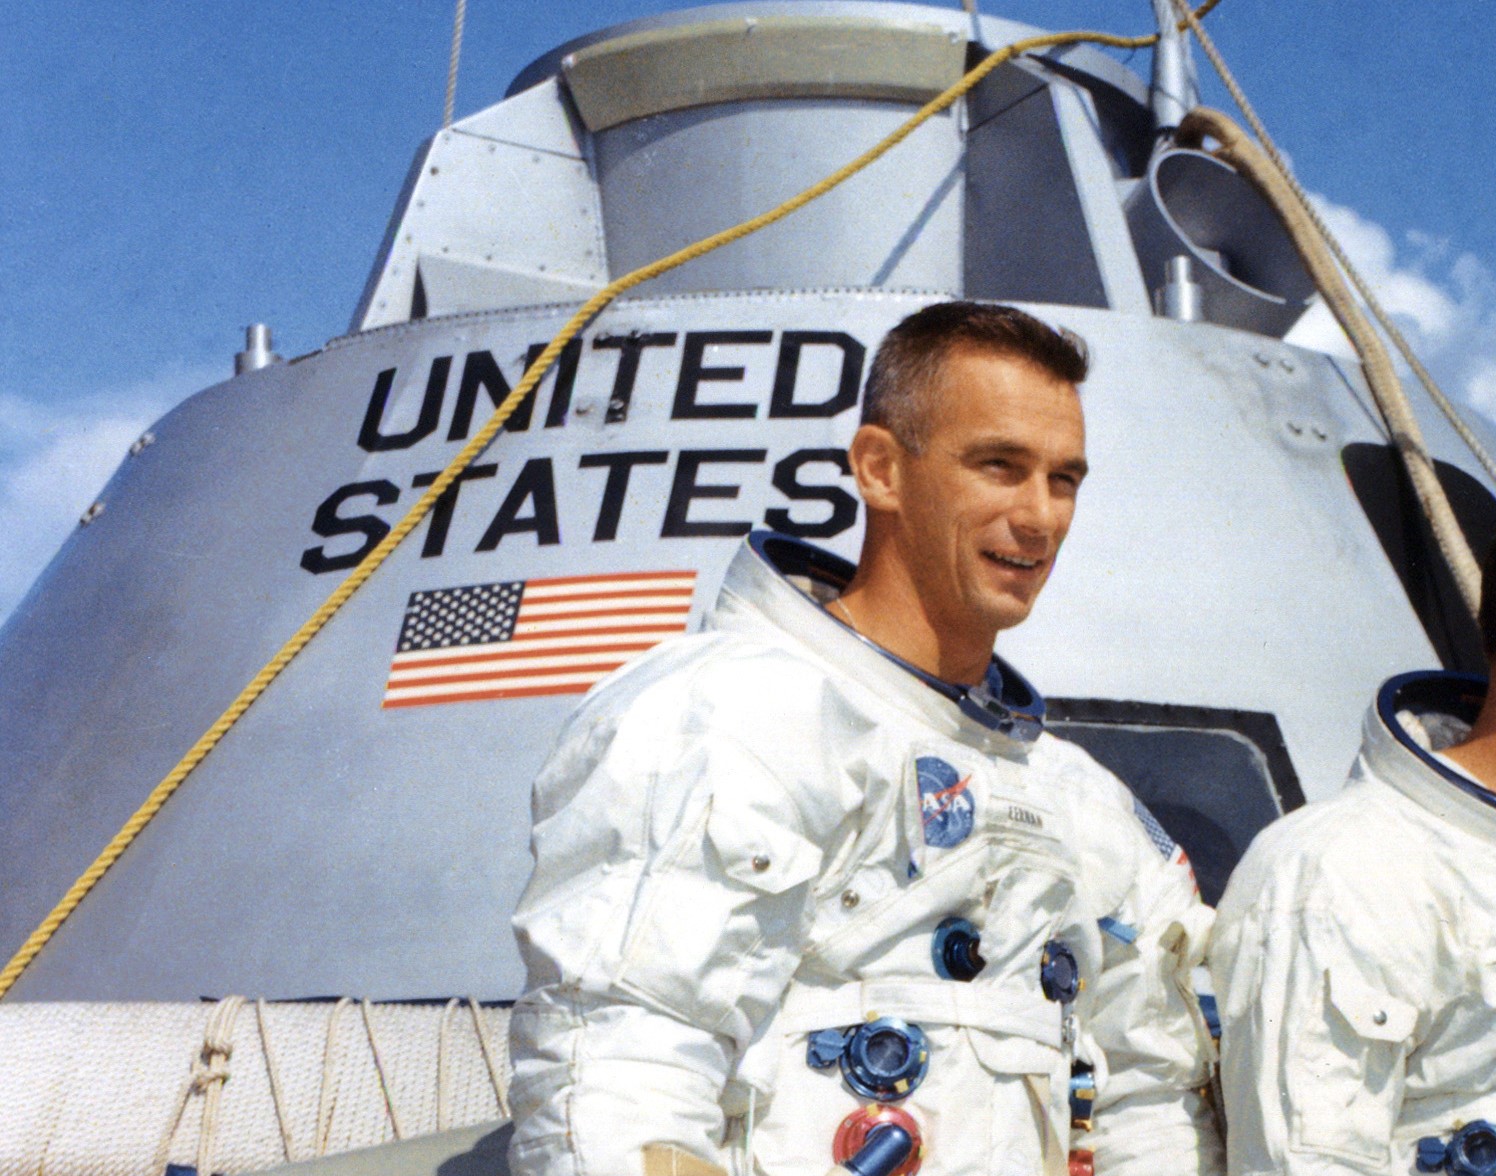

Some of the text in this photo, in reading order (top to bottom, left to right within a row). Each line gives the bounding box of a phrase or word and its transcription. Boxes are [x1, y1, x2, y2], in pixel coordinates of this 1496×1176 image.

[357, 330, 867, 453] UNITED
[300, 448, 859, 575] STATES
[921, 792, 971, 813] ASA
